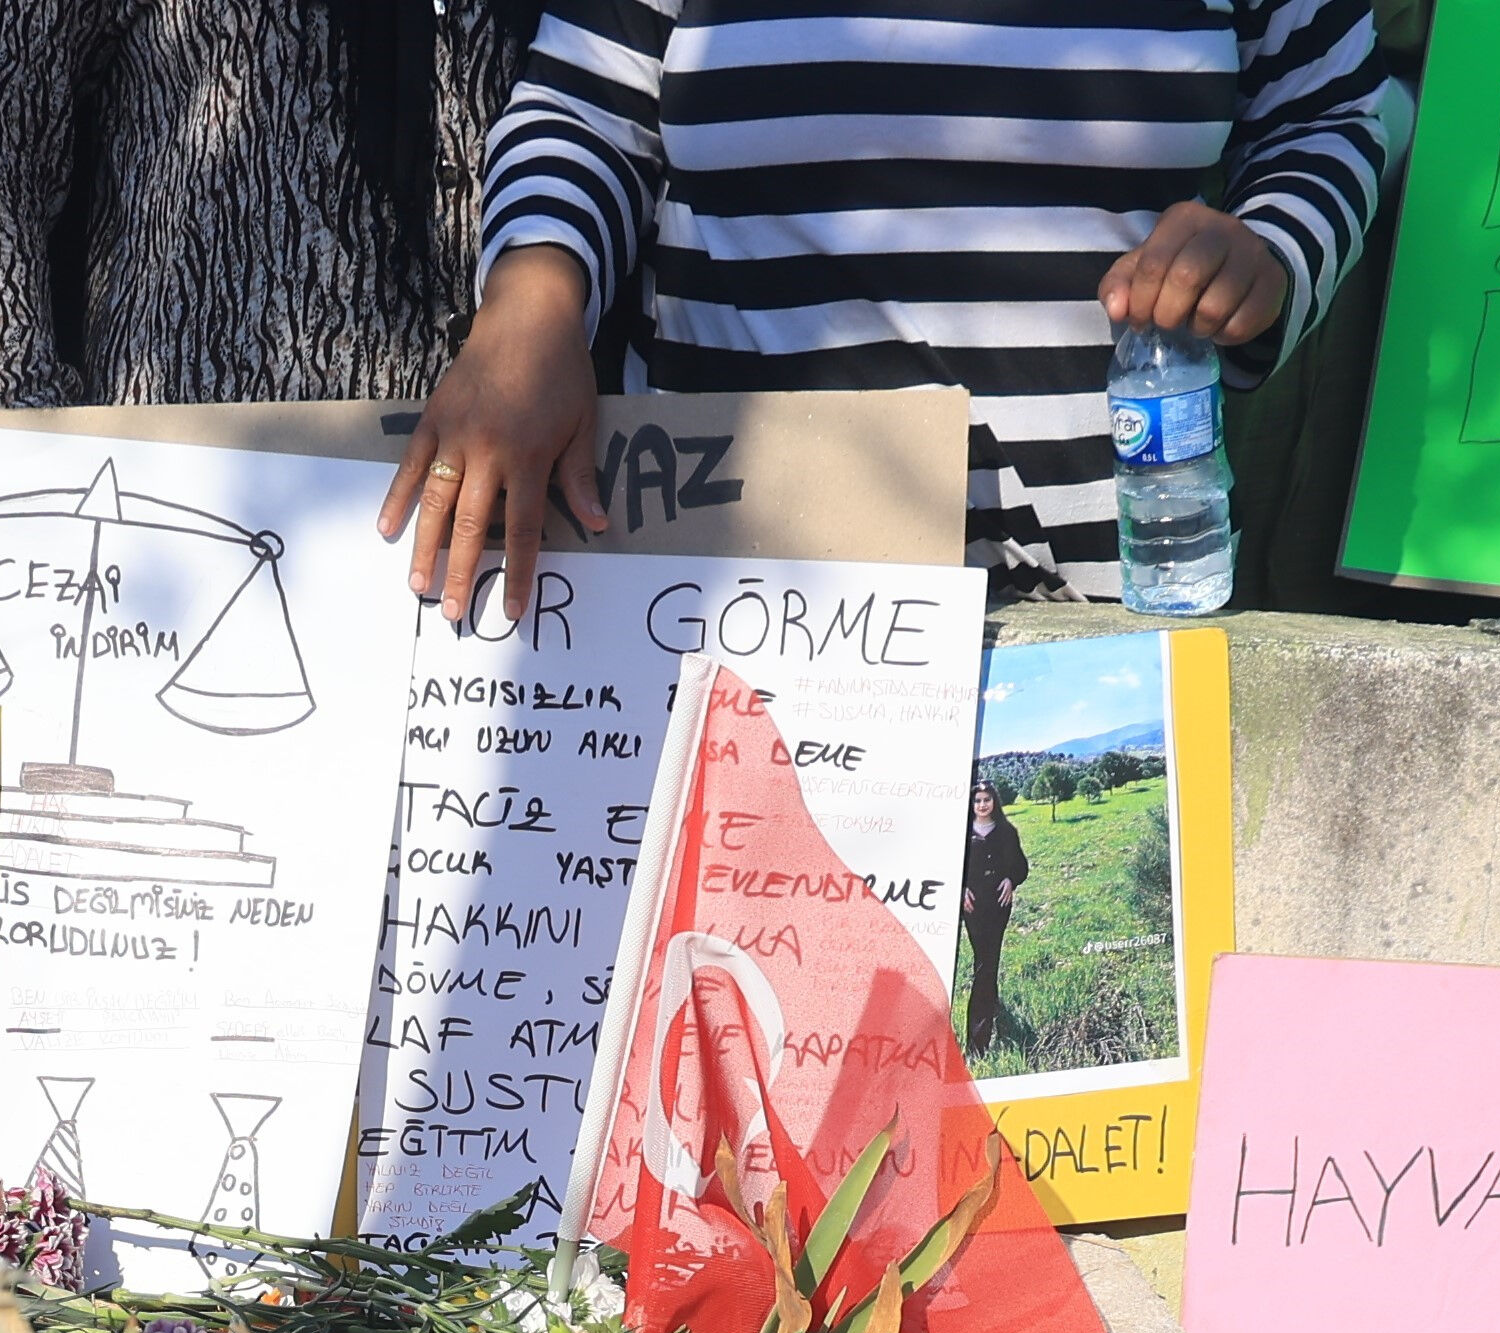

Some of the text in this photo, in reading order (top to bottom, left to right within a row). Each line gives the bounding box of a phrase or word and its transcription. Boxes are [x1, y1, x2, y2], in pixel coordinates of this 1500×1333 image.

[49, 621, 180, 661] İNDİRİM
[646, 578, 941, 667] GÖRME
[477, 726, 552, 754] UZUN
[578, 730, 642, 759] AKLI
[770, 738, 867, 772] DEME
[556, 851, 638, 889] YAŞT
[229, 898, 314, 927] NEDEN
[378, 893, 582, 950] HAKKINI
[378, 961, 527, 1000] DÖVME
[366, 1014, 474, 1055] LAF
[509, 1019, 600, 1058] ATM
